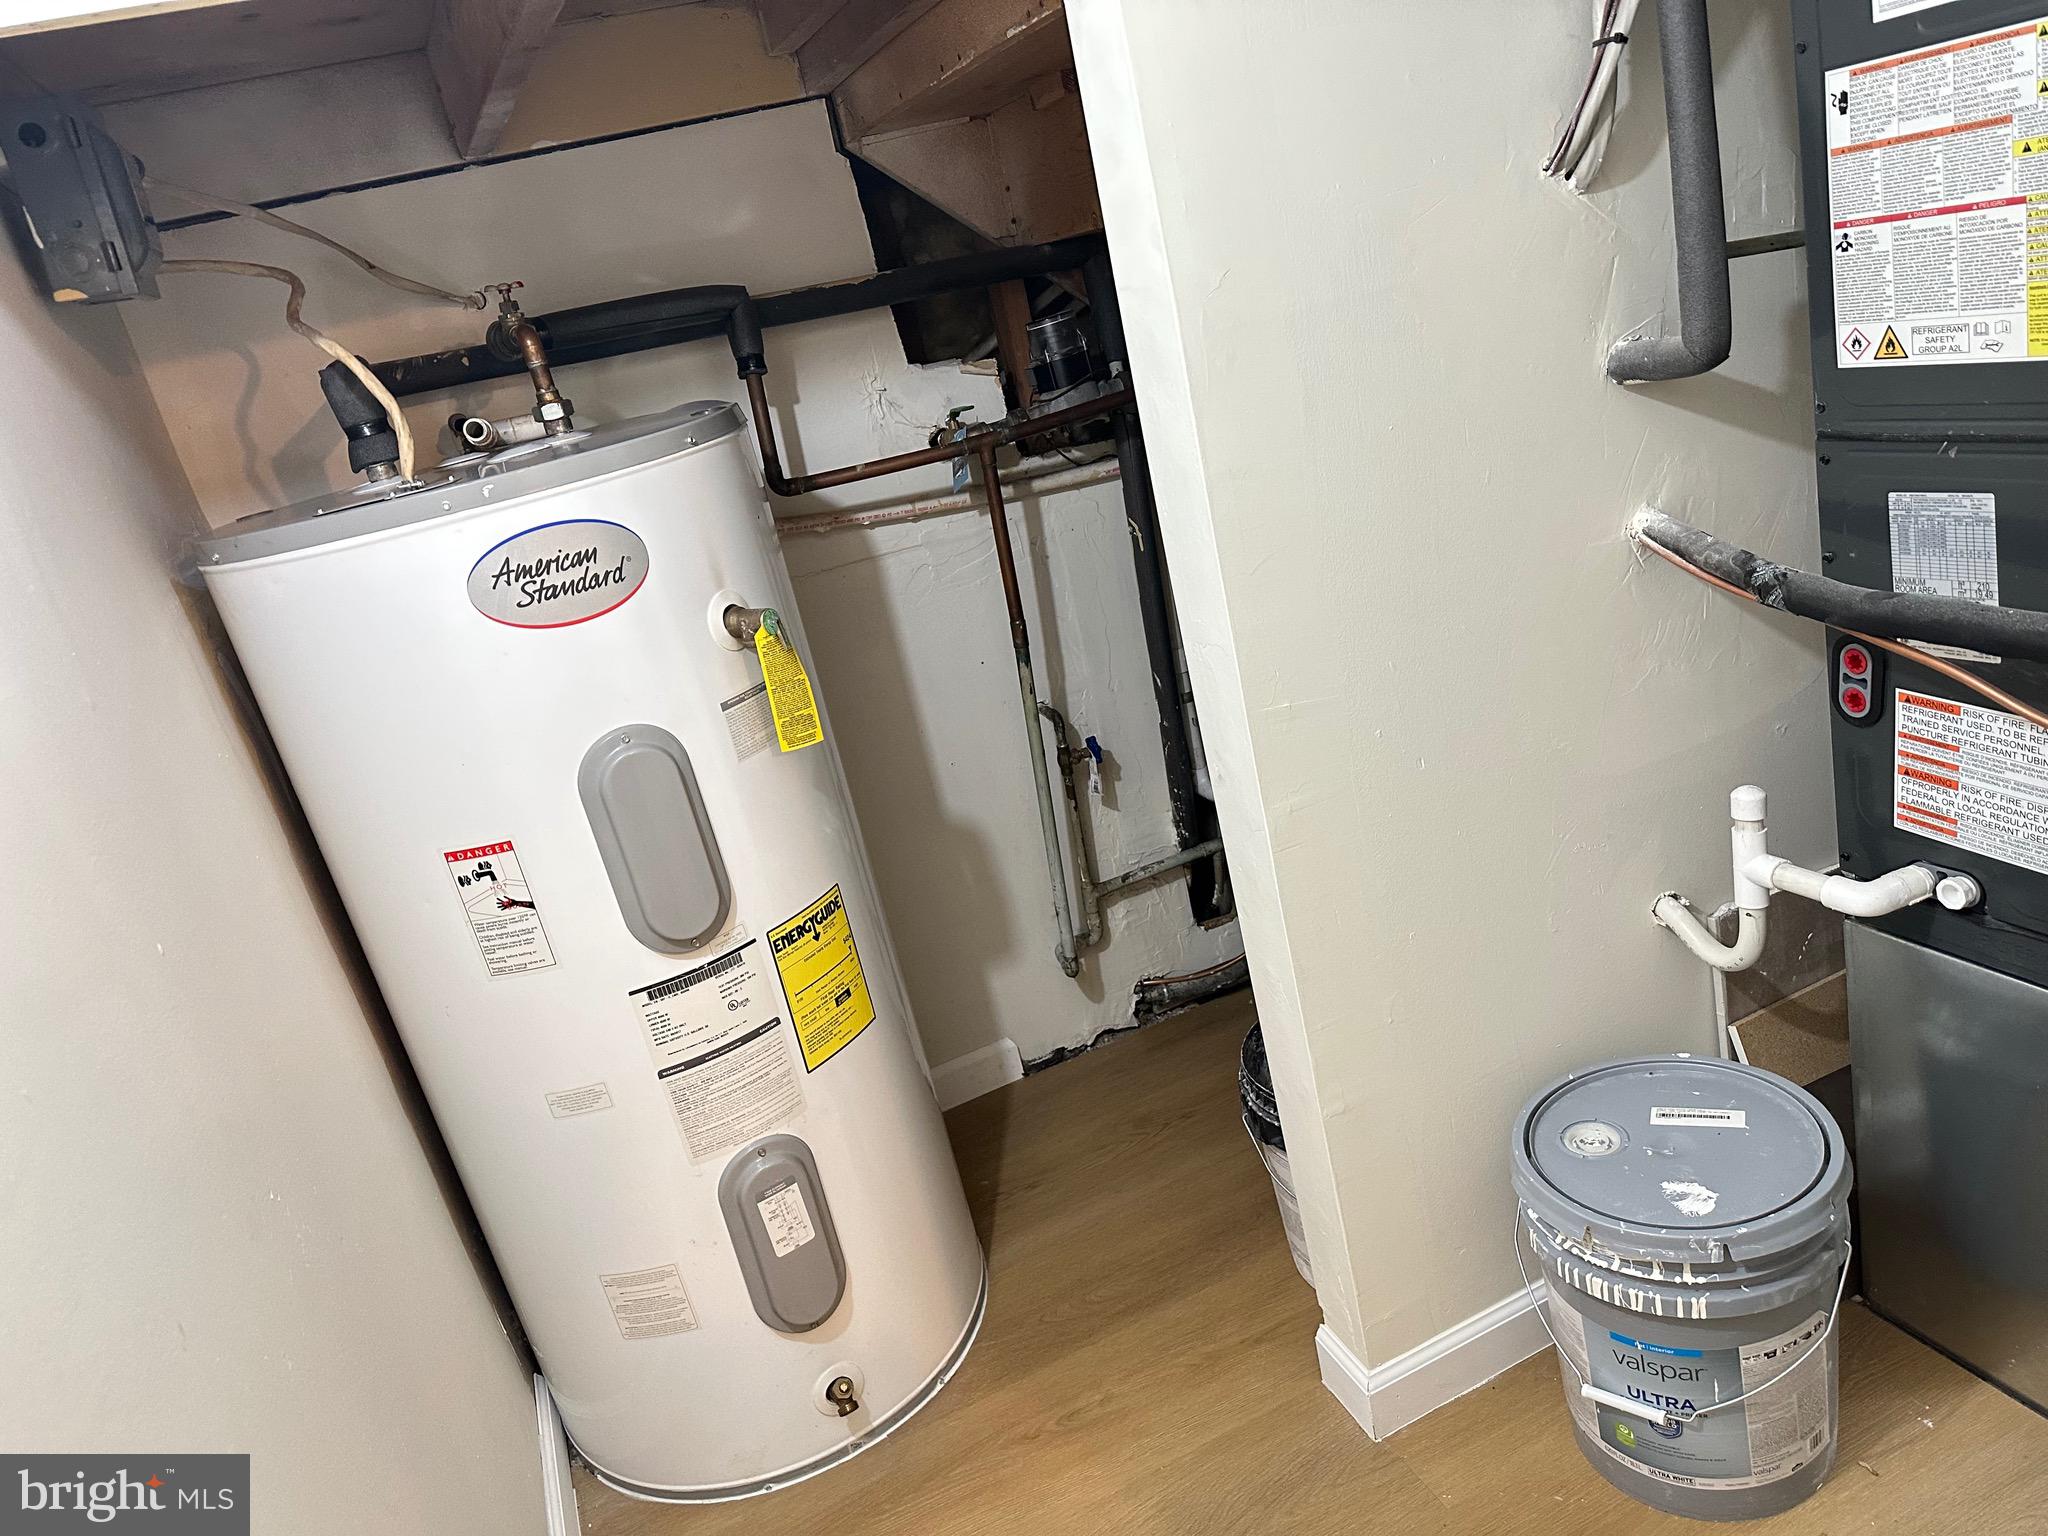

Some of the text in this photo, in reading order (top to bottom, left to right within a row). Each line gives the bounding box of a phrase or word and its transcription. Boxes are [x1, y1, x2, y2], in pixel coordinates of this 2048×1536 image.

[1914, 209, 1938, 218] DANGER
[1978, 200, 2006, 208] PELIGRO
[1912, 325, 1967, 335] REFRIGERANT
[1925, 335, 1956, 344] SAFETY
[1918, 344, 1963, 354] GROUP A2L
[492, 547, 598, 590] American
[516, 556, 626, 608] Standard
[1894, 576, 1990, 591] MINIMUM 210
[1894, 584, 1917, 594] ROOM
[1918, 586, 1938, 595] AREA
[1902, 704, 1964, 725] REFRIGERANT
[1998, 726, 2010, 737] TO
[2014, 730, 2026, 741] BE
[1910, 696, 1954, 713] WARNING
[1963, 709, 1985, 721] RISK
[1986, 714, 2000, 724] OF
[1902, 714, 1940, 730] TRAINED
[1942, 724, 1981, 740] SERVICE
[1902, 724, 1949, 742] PUNCTURE
[1952, 736, 2018, 760] REFRIGERANT
[2020, 754, 2048, 766] TUBIN
[1910, 770, 1952, 788] WARNING
[1961, 784, 1982, 797] RISK
[1984, 790, 1998, 800] OF
[1901, 786, 1940, 804] FEDERAL
[1942, 798, 1955, 808] OR
[1957, 802, 1987, 818] LOCAL
[1902, 776, 1959, 799] OFPROPERLY
[1962, 794, 1971, 803] IN
[1972, 798, 2040, 823] ACCORDANCE
[1901, 795, 1951, 816] FLAMMABLE
[1954, 811, 2020, 836] REFRIGERANT
[457, 844, 510, 860] DANGER
[772, 894, 841, 954] ENERGYGUIDE
[759, 1021, 778, 1034] CAUTION
[1650, 1346, 1674, 1354] interior
[1612, 1349, 1704, 1382] valspar
[1627, 1384, 1697, 1412] ULTRA
[1649, 1468, 1696, 1483] ULTRA WHITE
[1753, 1462, 1782, 1476] valspar
